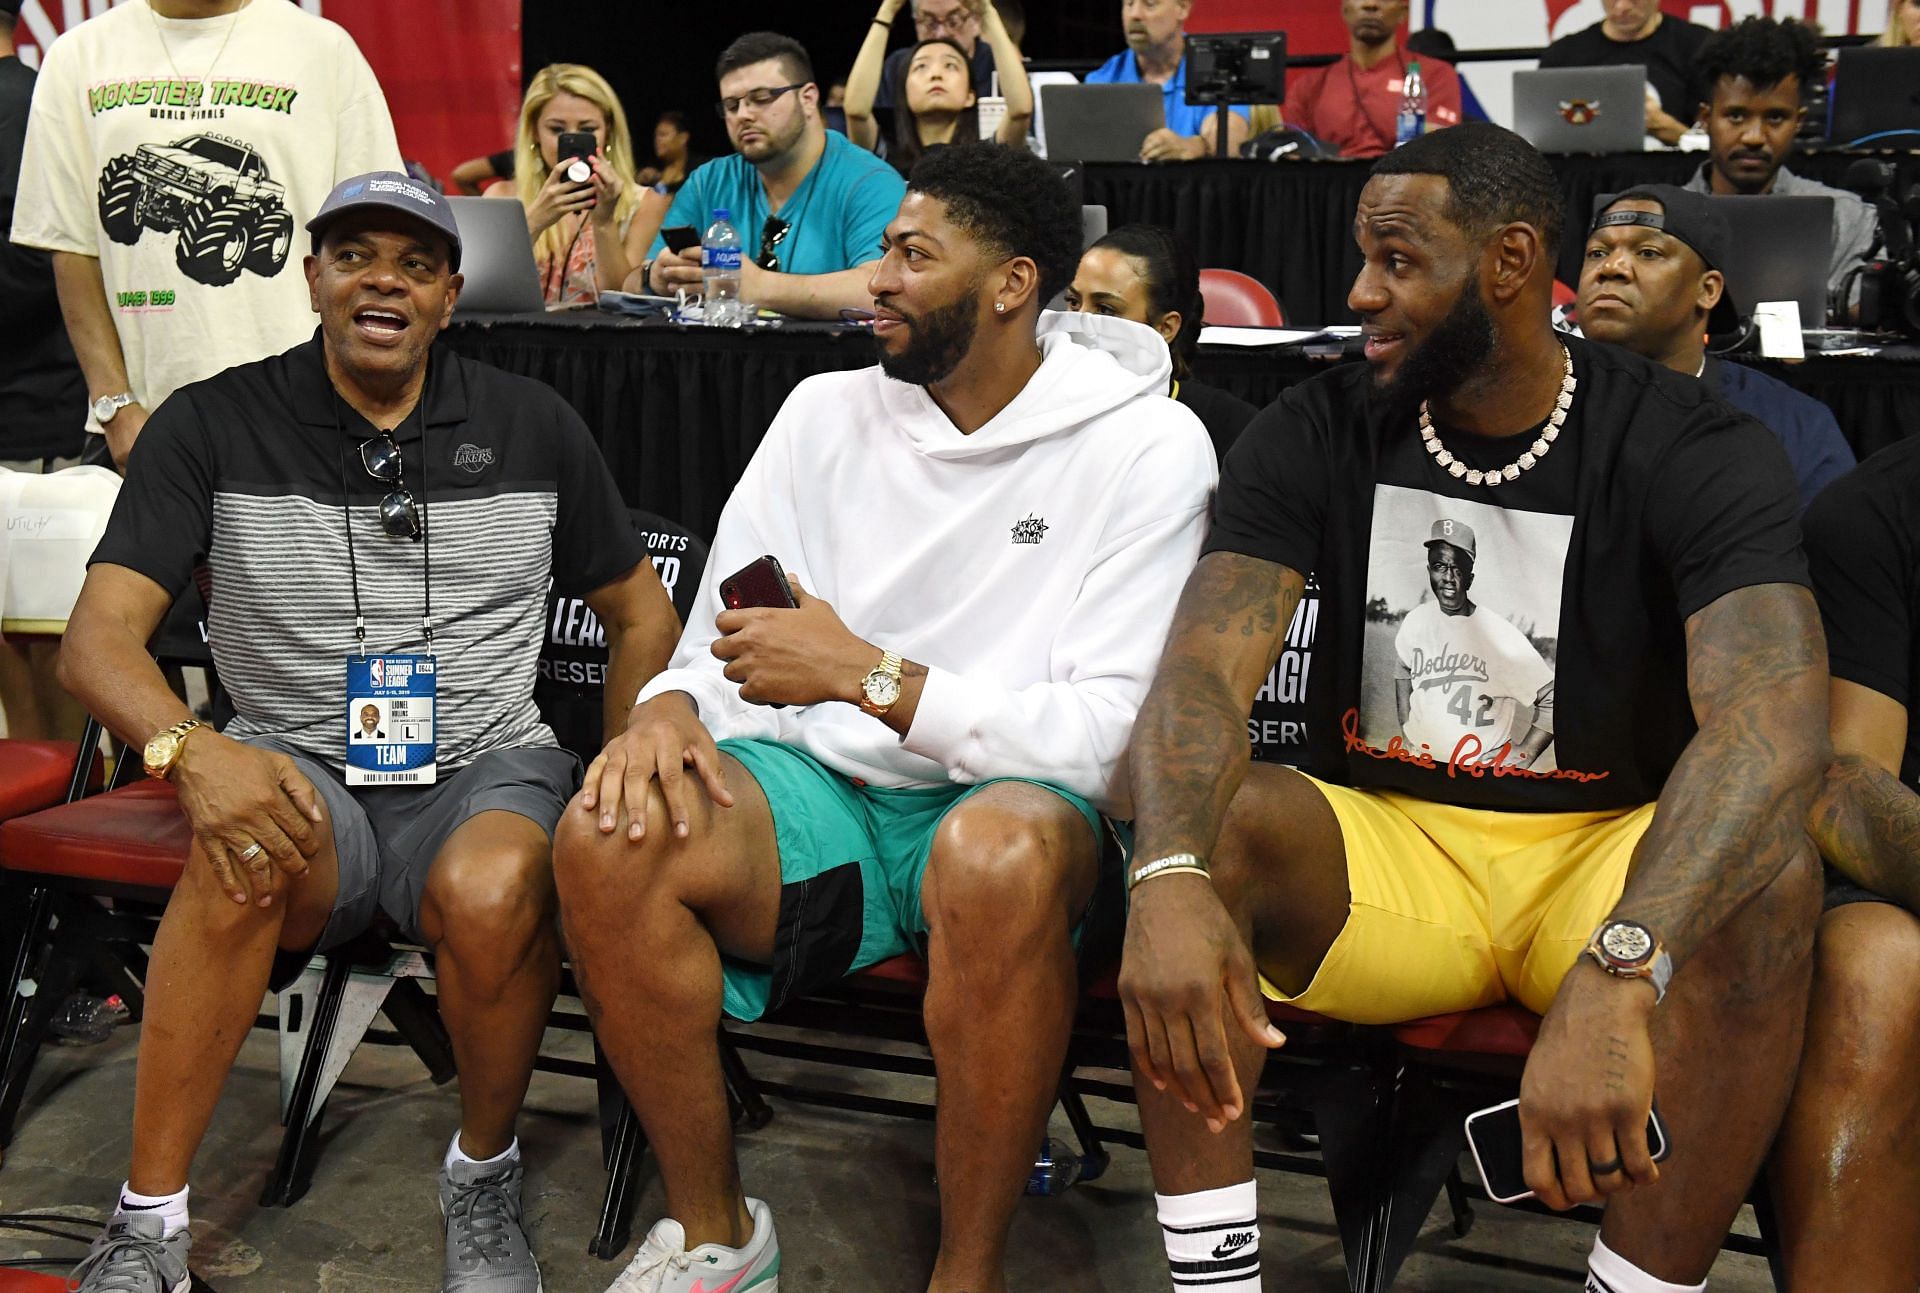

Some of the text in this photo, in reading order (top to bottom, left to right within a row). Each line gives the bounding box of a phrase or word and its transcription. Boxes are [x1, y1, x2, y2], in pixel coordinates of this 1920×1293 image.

[89, 80, 298, 117] MONSTER TRUCK
[150, 108, 225, 120] WORLD FINALS
[149, 289, 176, 306] 1999
[453, 450, 492, 466] LAKERS
[1443, 520, 1453, 536] B
[385, 664, 413, 676] SUMMER
[1411, 643, 1489, 692] Dodgers
[385, 675, 409, 687] LEAGUE
[391, 700, 408, 710] LIONEL
[1446, 684, 1495, 728] 42
[405, 726, 415, 739] L
[1341, 706, 1437, 770] Jackie
[1447, 733, 1610, 783] Robinson
[375, 745, 407, 765] TEAM
